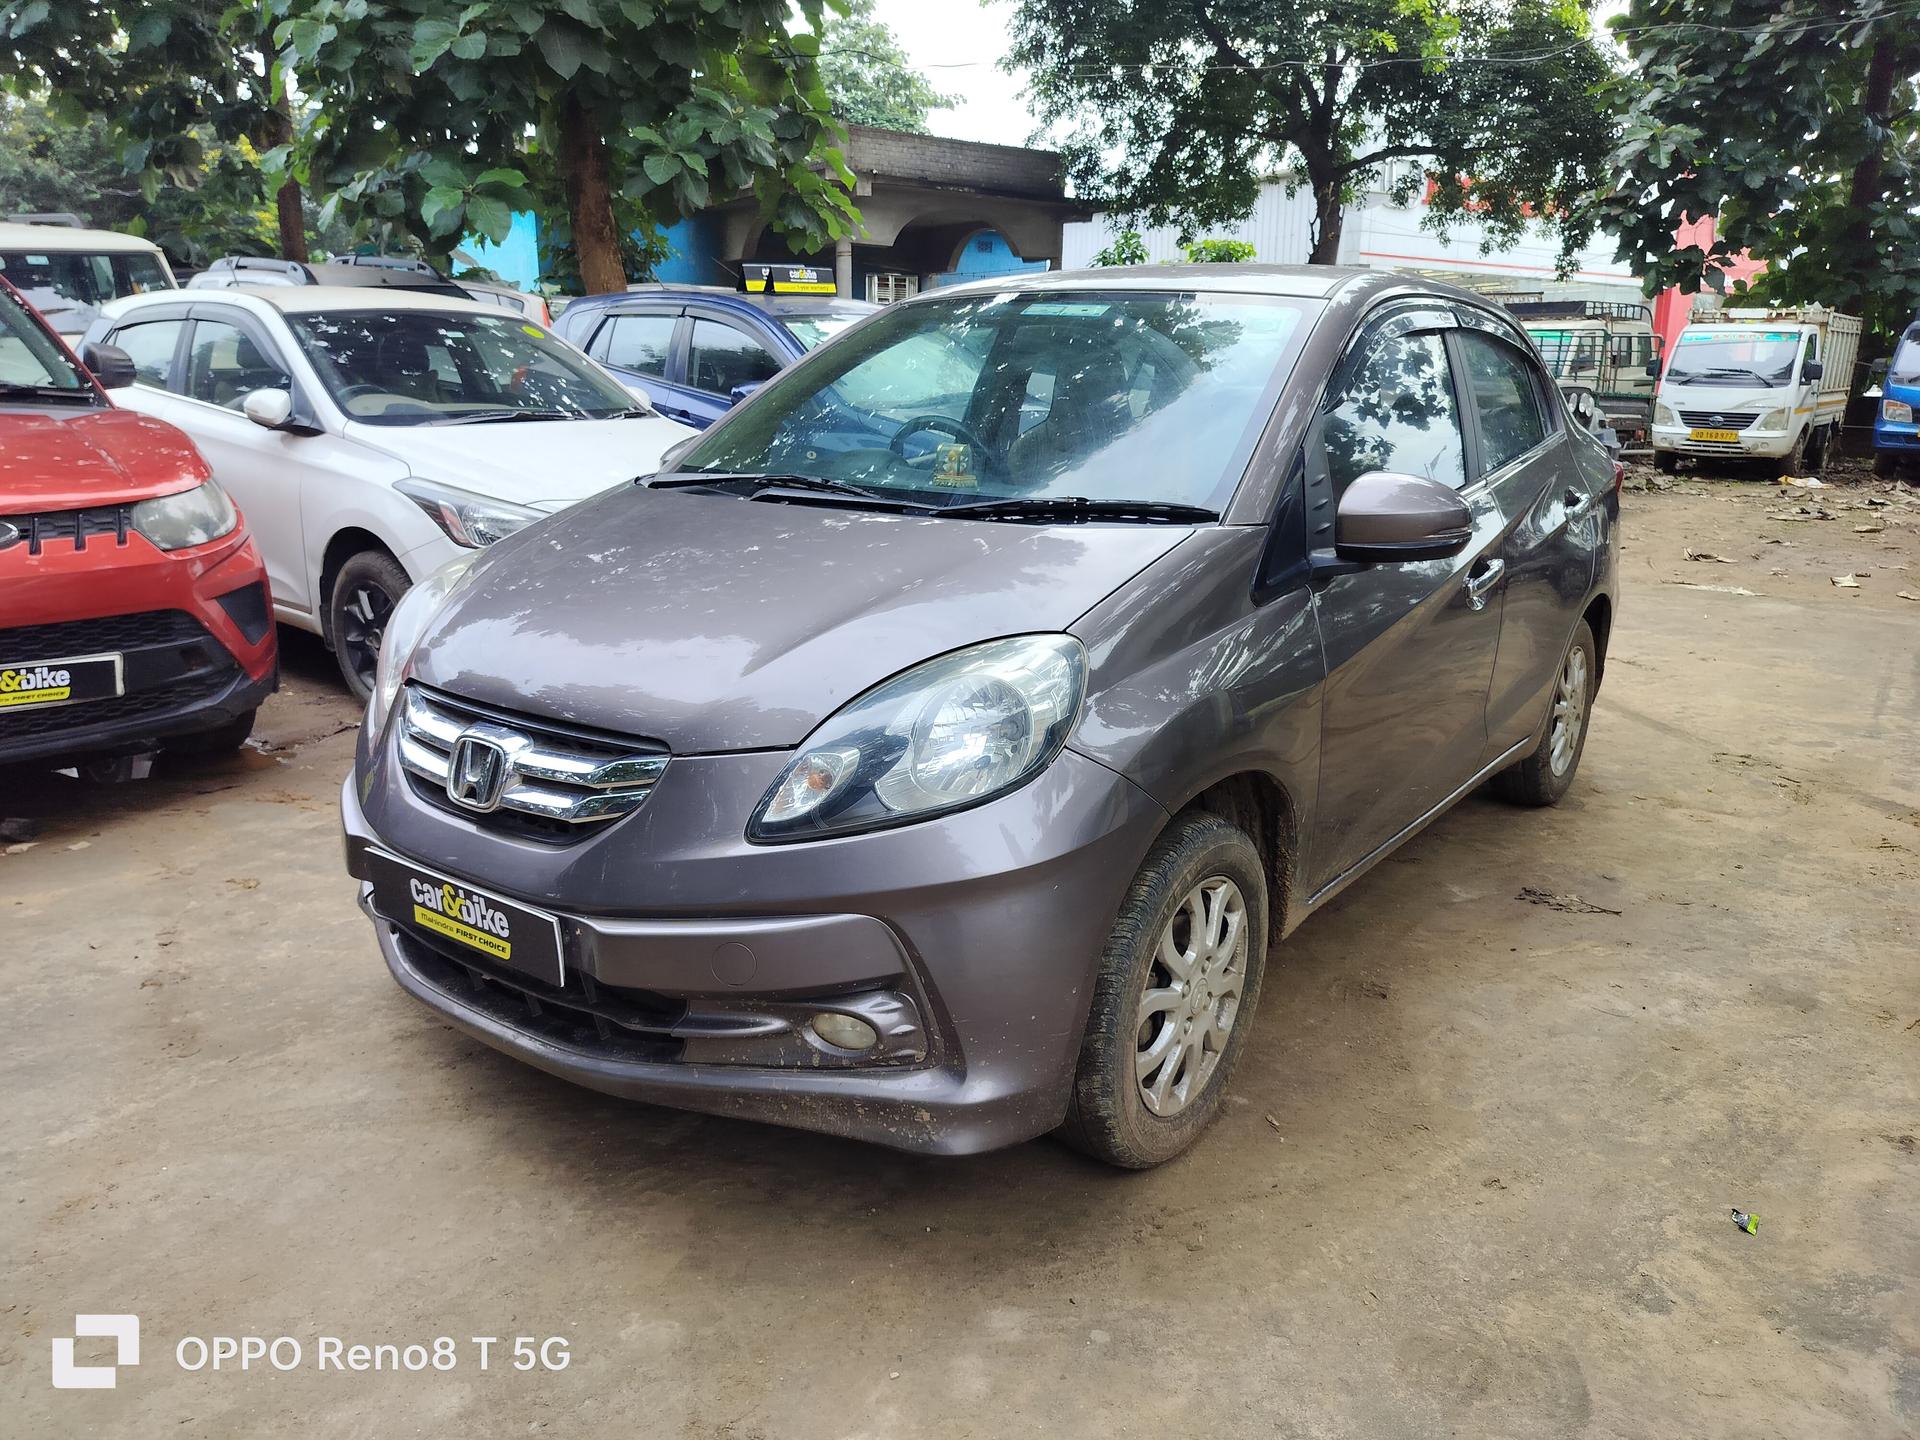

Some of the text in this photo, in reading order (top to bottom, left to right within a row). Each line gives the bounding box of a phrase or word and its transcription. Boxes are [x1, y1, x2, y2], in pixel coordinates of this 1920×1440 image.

[0, 667, 71, 692] &bike
[409, 877, 511, 938] car&bike
[455, 927, 477, 943] FIRST
[478, 937, 507, 954] CHOICE
